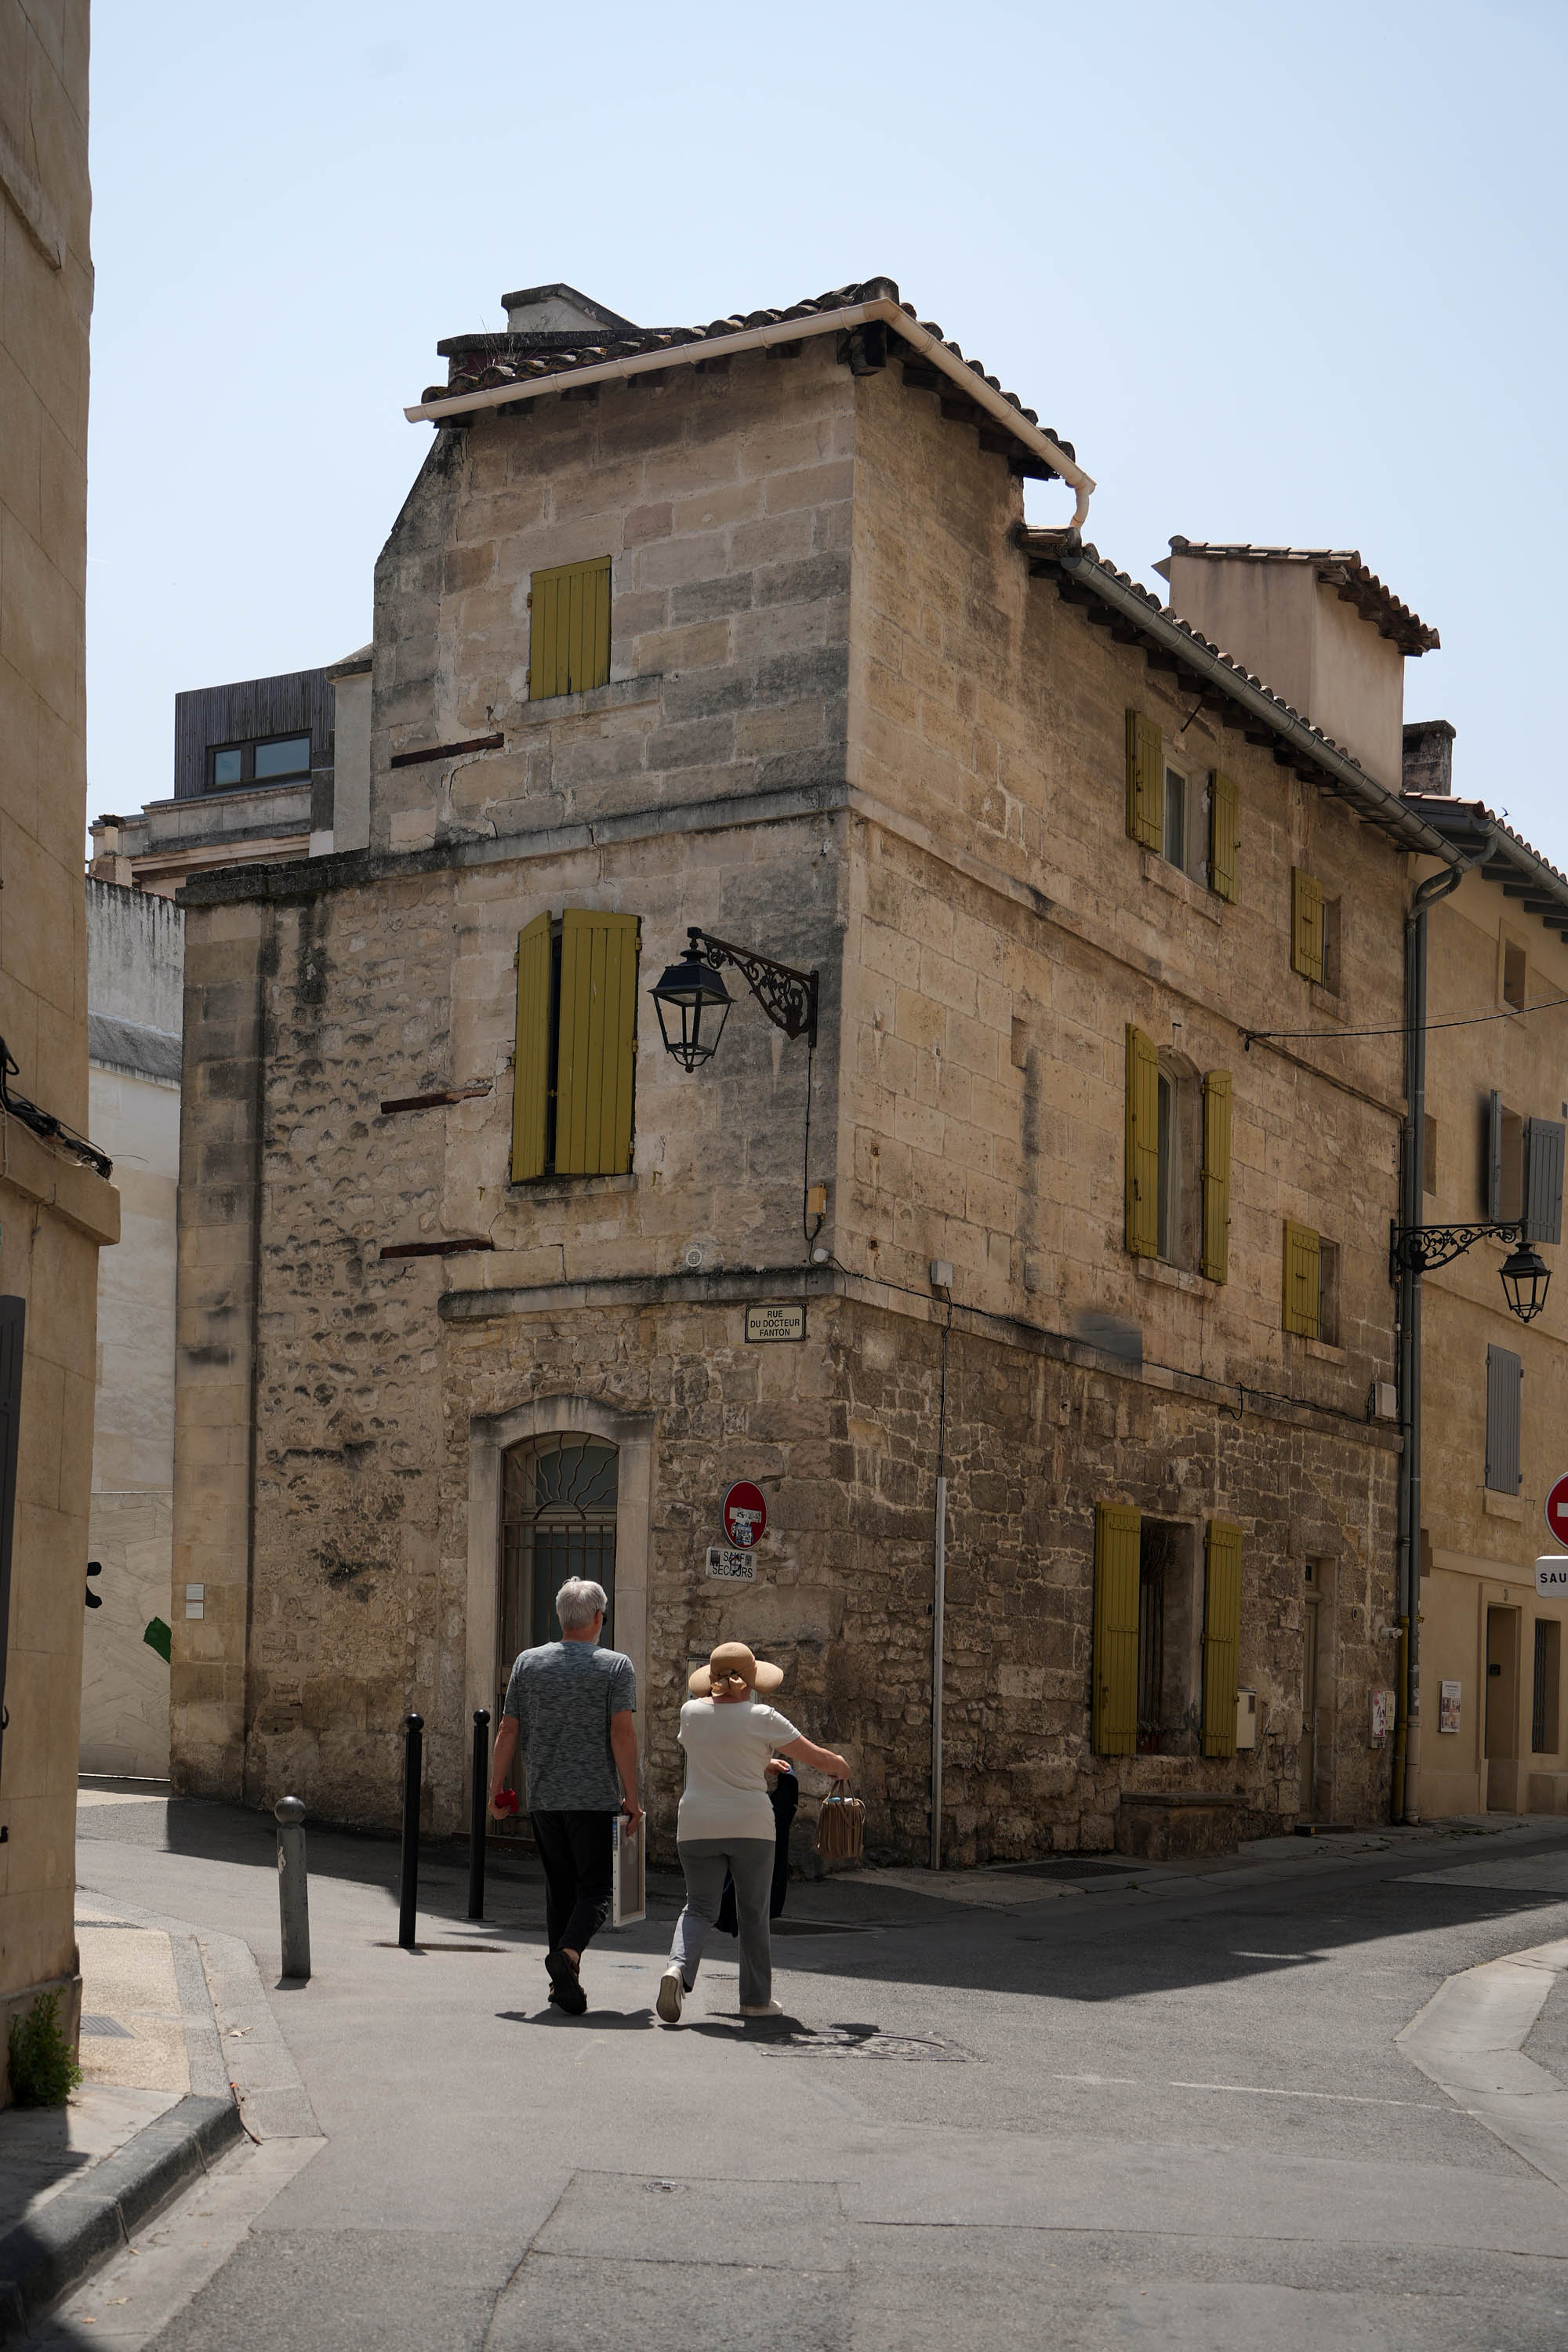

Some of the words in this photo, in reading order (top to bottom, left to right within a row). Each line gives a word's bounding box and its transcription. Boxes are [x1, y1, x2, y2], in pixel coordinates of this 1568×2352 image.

[763, 1319, 800, 1327] DOCTEUR
[759, 1328, 790, 1337] FANTON
[712, 1565, 753, 1578] SECURS
